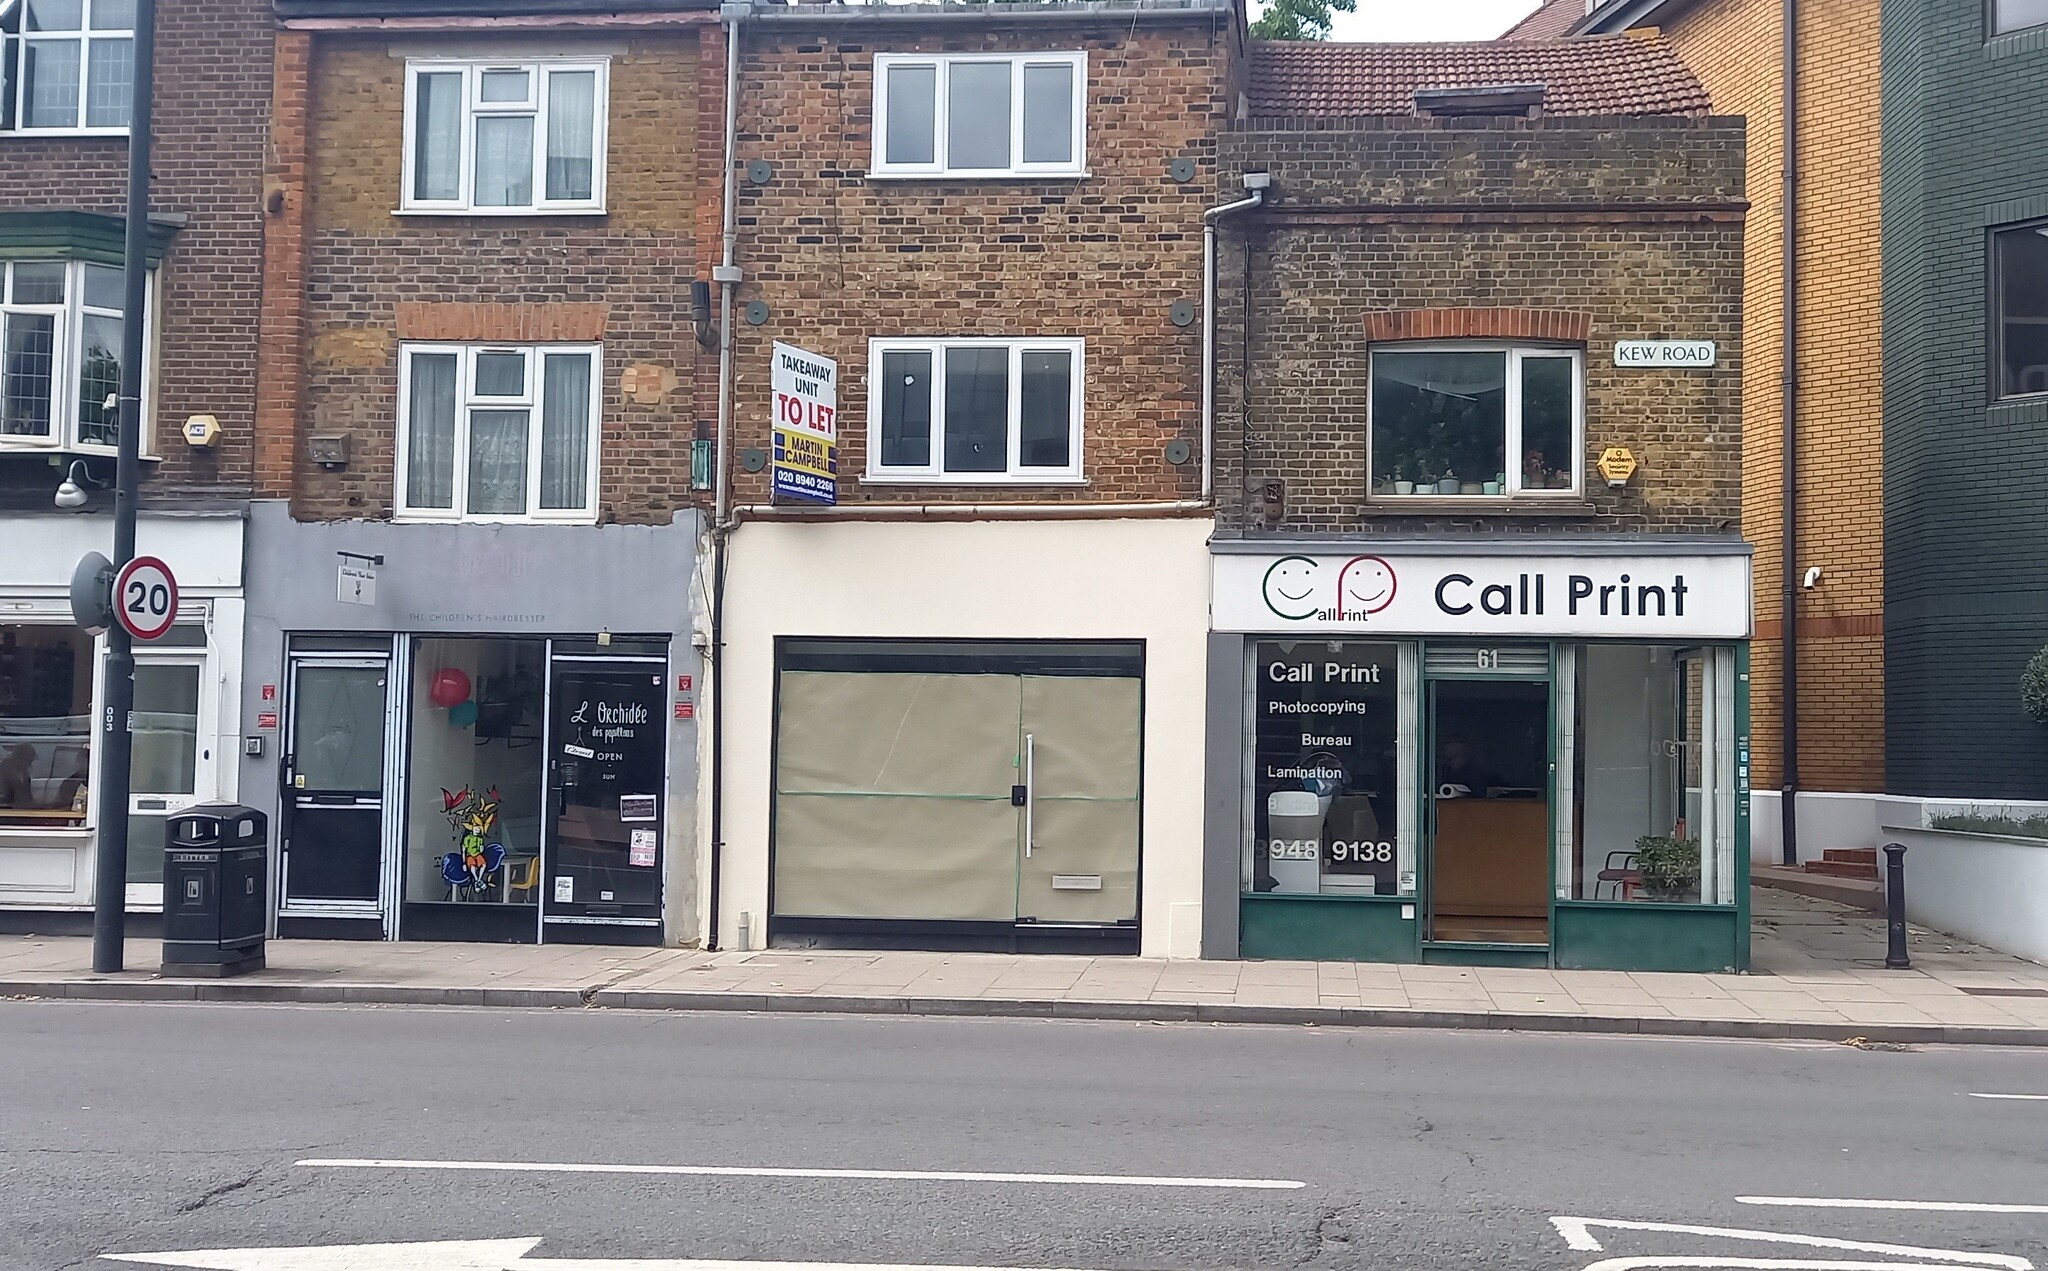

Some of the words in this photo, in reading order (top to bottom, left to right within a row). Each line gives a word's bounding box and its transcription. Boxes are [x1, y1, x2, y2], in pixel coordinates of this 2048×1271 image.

[1619, 346, 1657, 361] KEW
[1663, 346, 1710, 361] ROAD
[781, 353, 831, 383] TAKEAWAY
[795, 377, 818, 397] UNIT
[778, 393, 802, 425] TO
[808, 402, 833, 434] LET
[791, 436, 823, 456] MARTIN
[785, 449, 828, 472] CAMPBELL
[778, 470, 793, 482] 020
[795, 473, 815, 487] 8940
[128, 581, 168, 615] 20
[1435, 573, 1544, 615] Call
[1568, 574, 1689, 616] Print
[409, 613, 424, 621] THE
[1477, 649, 1498, 669] 61
[1269, 661, 1313, 682] Call
[1325, 662, 1380, 683] Print
[1269, 701, 1366, 715] Photocopying
[106, 706, 114, 731] 003
[1301, 733, 1352, 746] Bureau
[597, 752, 623, 761] OPEN
[1267, 765, 1342, 779] Lamination
[1332, 840, 1392, 863] 9138
